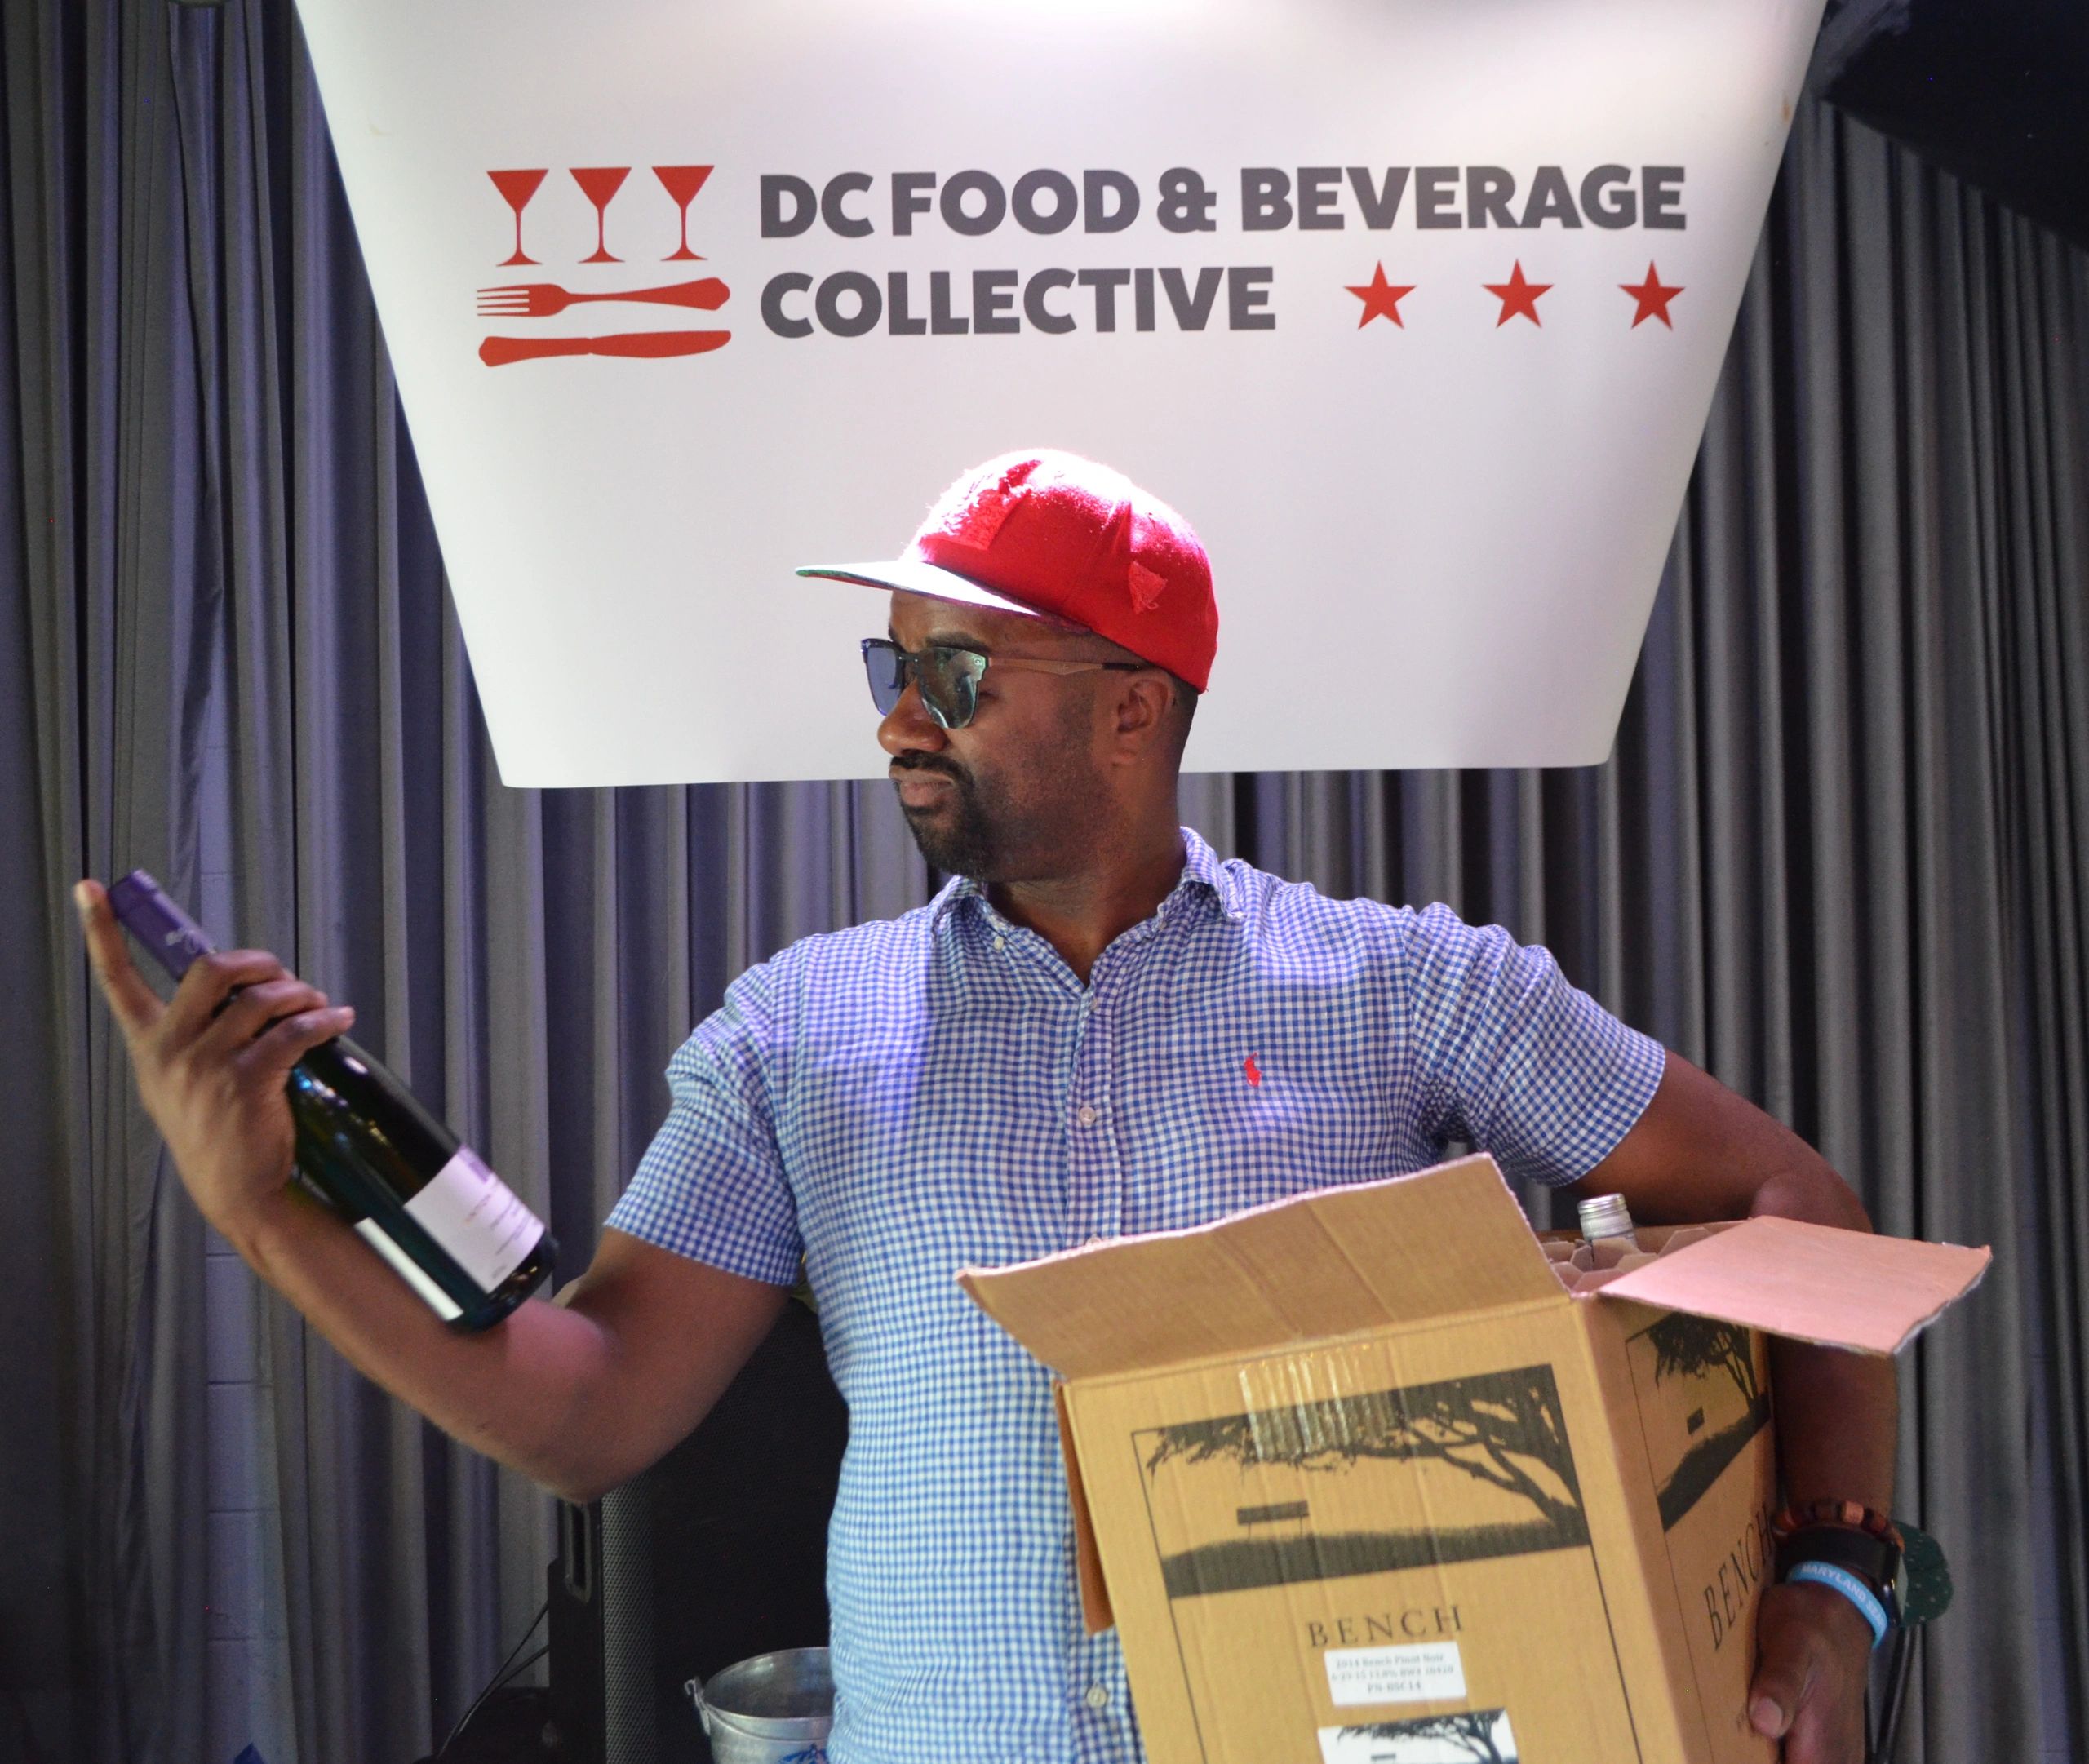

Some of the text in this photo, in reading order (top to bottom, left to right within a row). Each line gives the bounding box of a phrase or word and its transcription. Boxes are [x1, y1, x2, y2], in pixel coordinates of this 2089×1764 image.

[761, 165, 1686, 237] DC FOOD & BEVERAGE
[761, 267, 1275, 338] COLLECTIVE
[1704, 1504, 1774, 1651] BENCH
[1801, 1564, 1867, 1602] MARYLAND
[1307, 1605, 1463, 1647] BENCH
